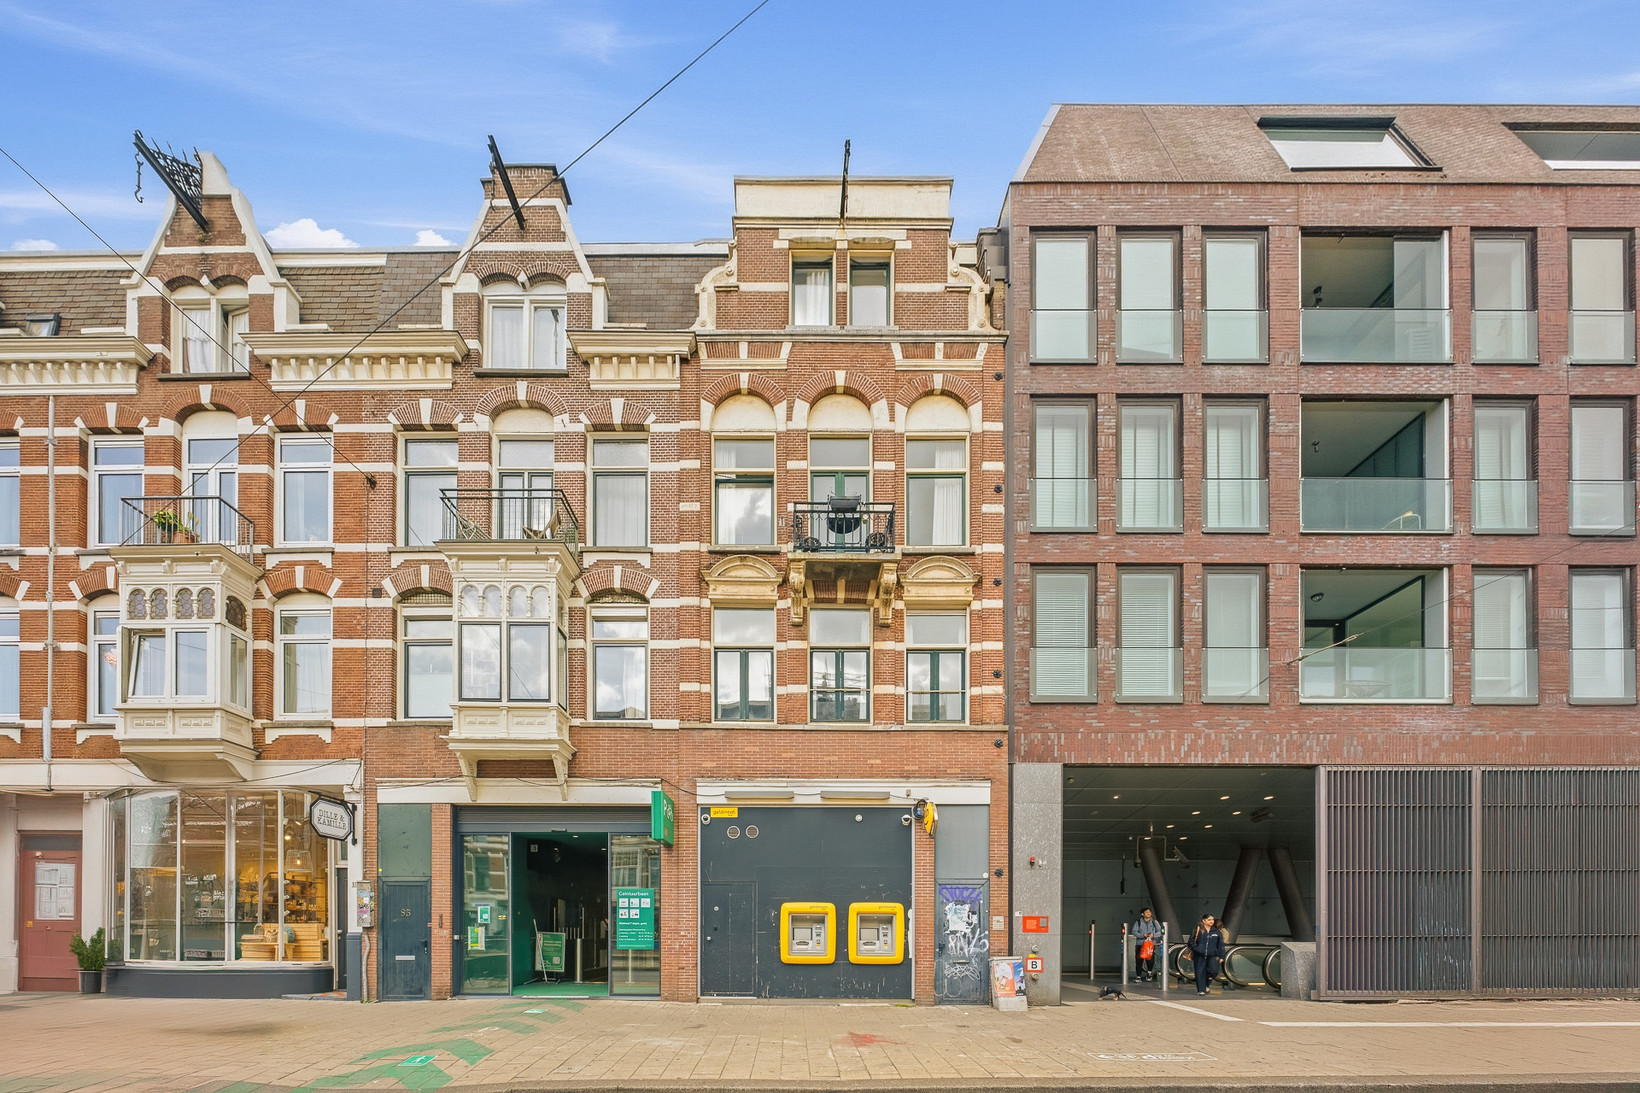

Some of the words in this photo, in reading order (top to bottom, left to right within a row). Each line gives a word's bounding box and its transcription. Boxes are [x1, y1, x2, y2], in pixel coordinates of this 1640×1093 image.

[318, 809, 338, 821] DILLE
[317, 816, 347, 830] KAMILLE
[1031, 961, 1038, 969] B
